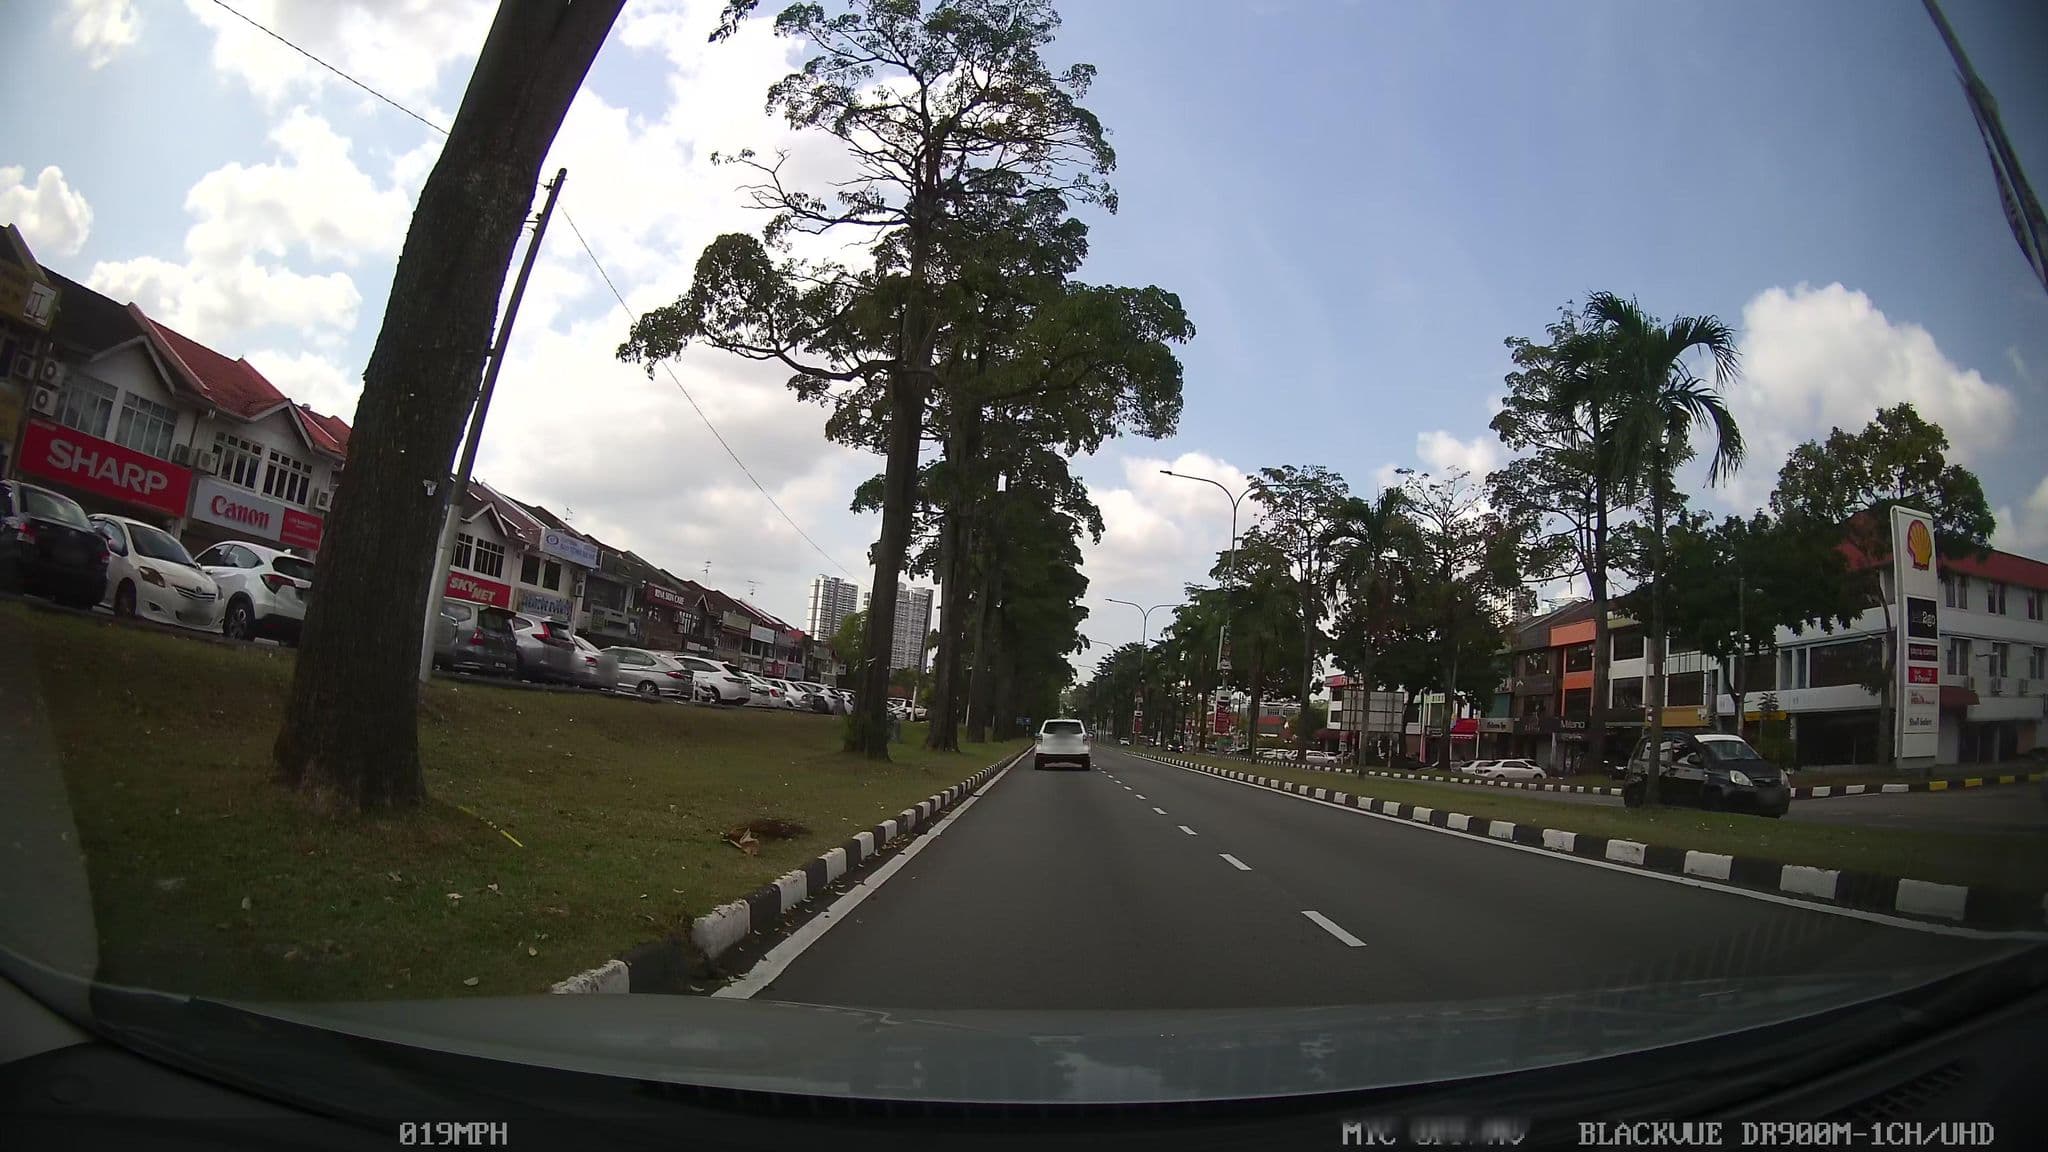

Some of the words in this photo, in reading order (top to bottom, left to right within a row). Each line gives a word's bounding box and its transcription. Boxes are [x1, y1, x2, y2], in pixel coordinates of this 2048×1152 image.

[47, 438, 168, 496] SHARP
[211, 495, 271, 530] Canon
[449, 577, 496, 602] SKYNET
